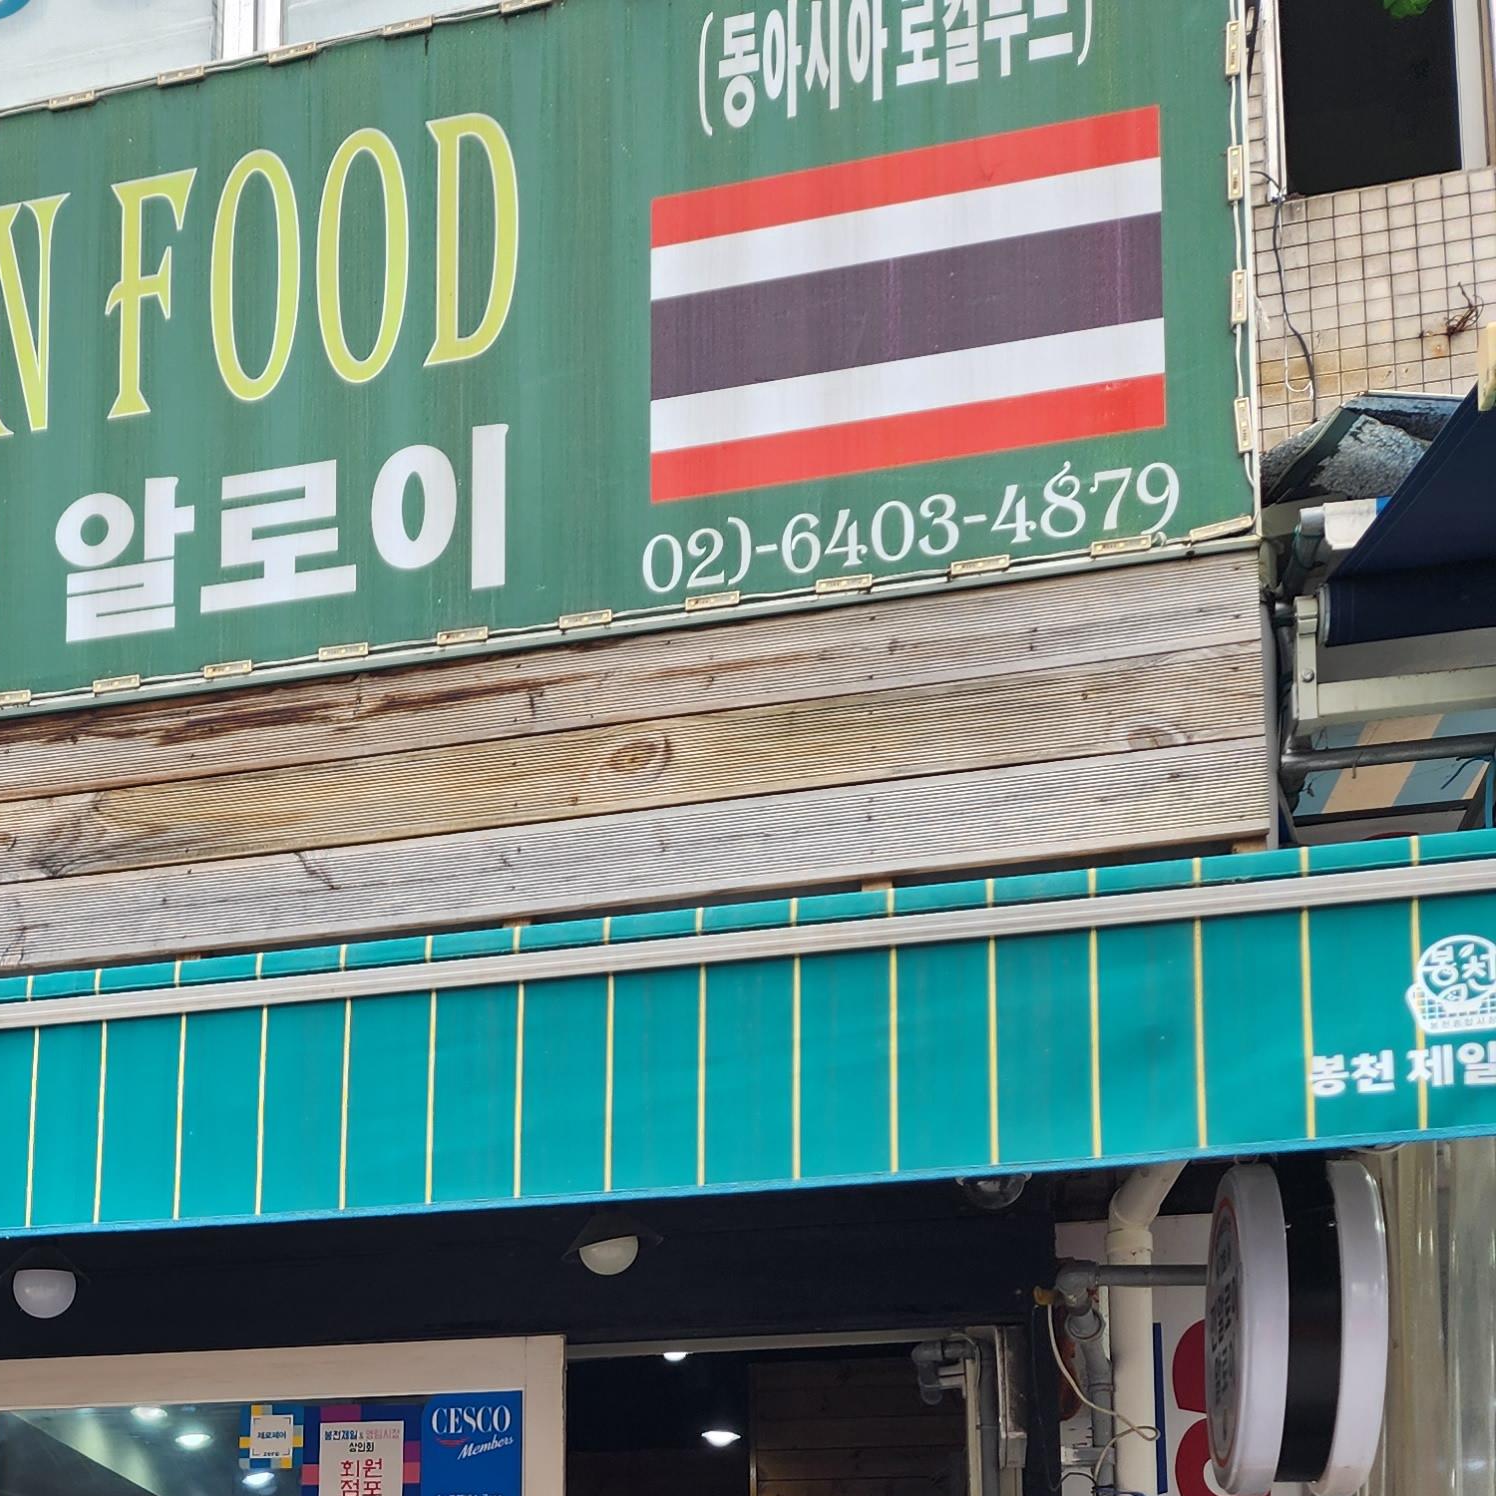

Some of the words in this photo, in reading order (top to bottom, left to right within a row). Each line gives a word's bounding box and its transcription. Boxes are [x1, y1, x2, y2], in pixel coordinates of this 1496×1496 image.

[105, 112, 519, 420] FOOD
[55, 424, 508, 644] 알로이
[643, 461, 1180, 594] 02)-6403-4879
[1309, 1049, 1395, 1098] 봉천
[1406, 1041, 1496, 1087] 제일
[431, 1405, 511, 1434] CESCO
[457, 1435, 514, 1461] Members
[340, 1458, 383, 1478] 회원
